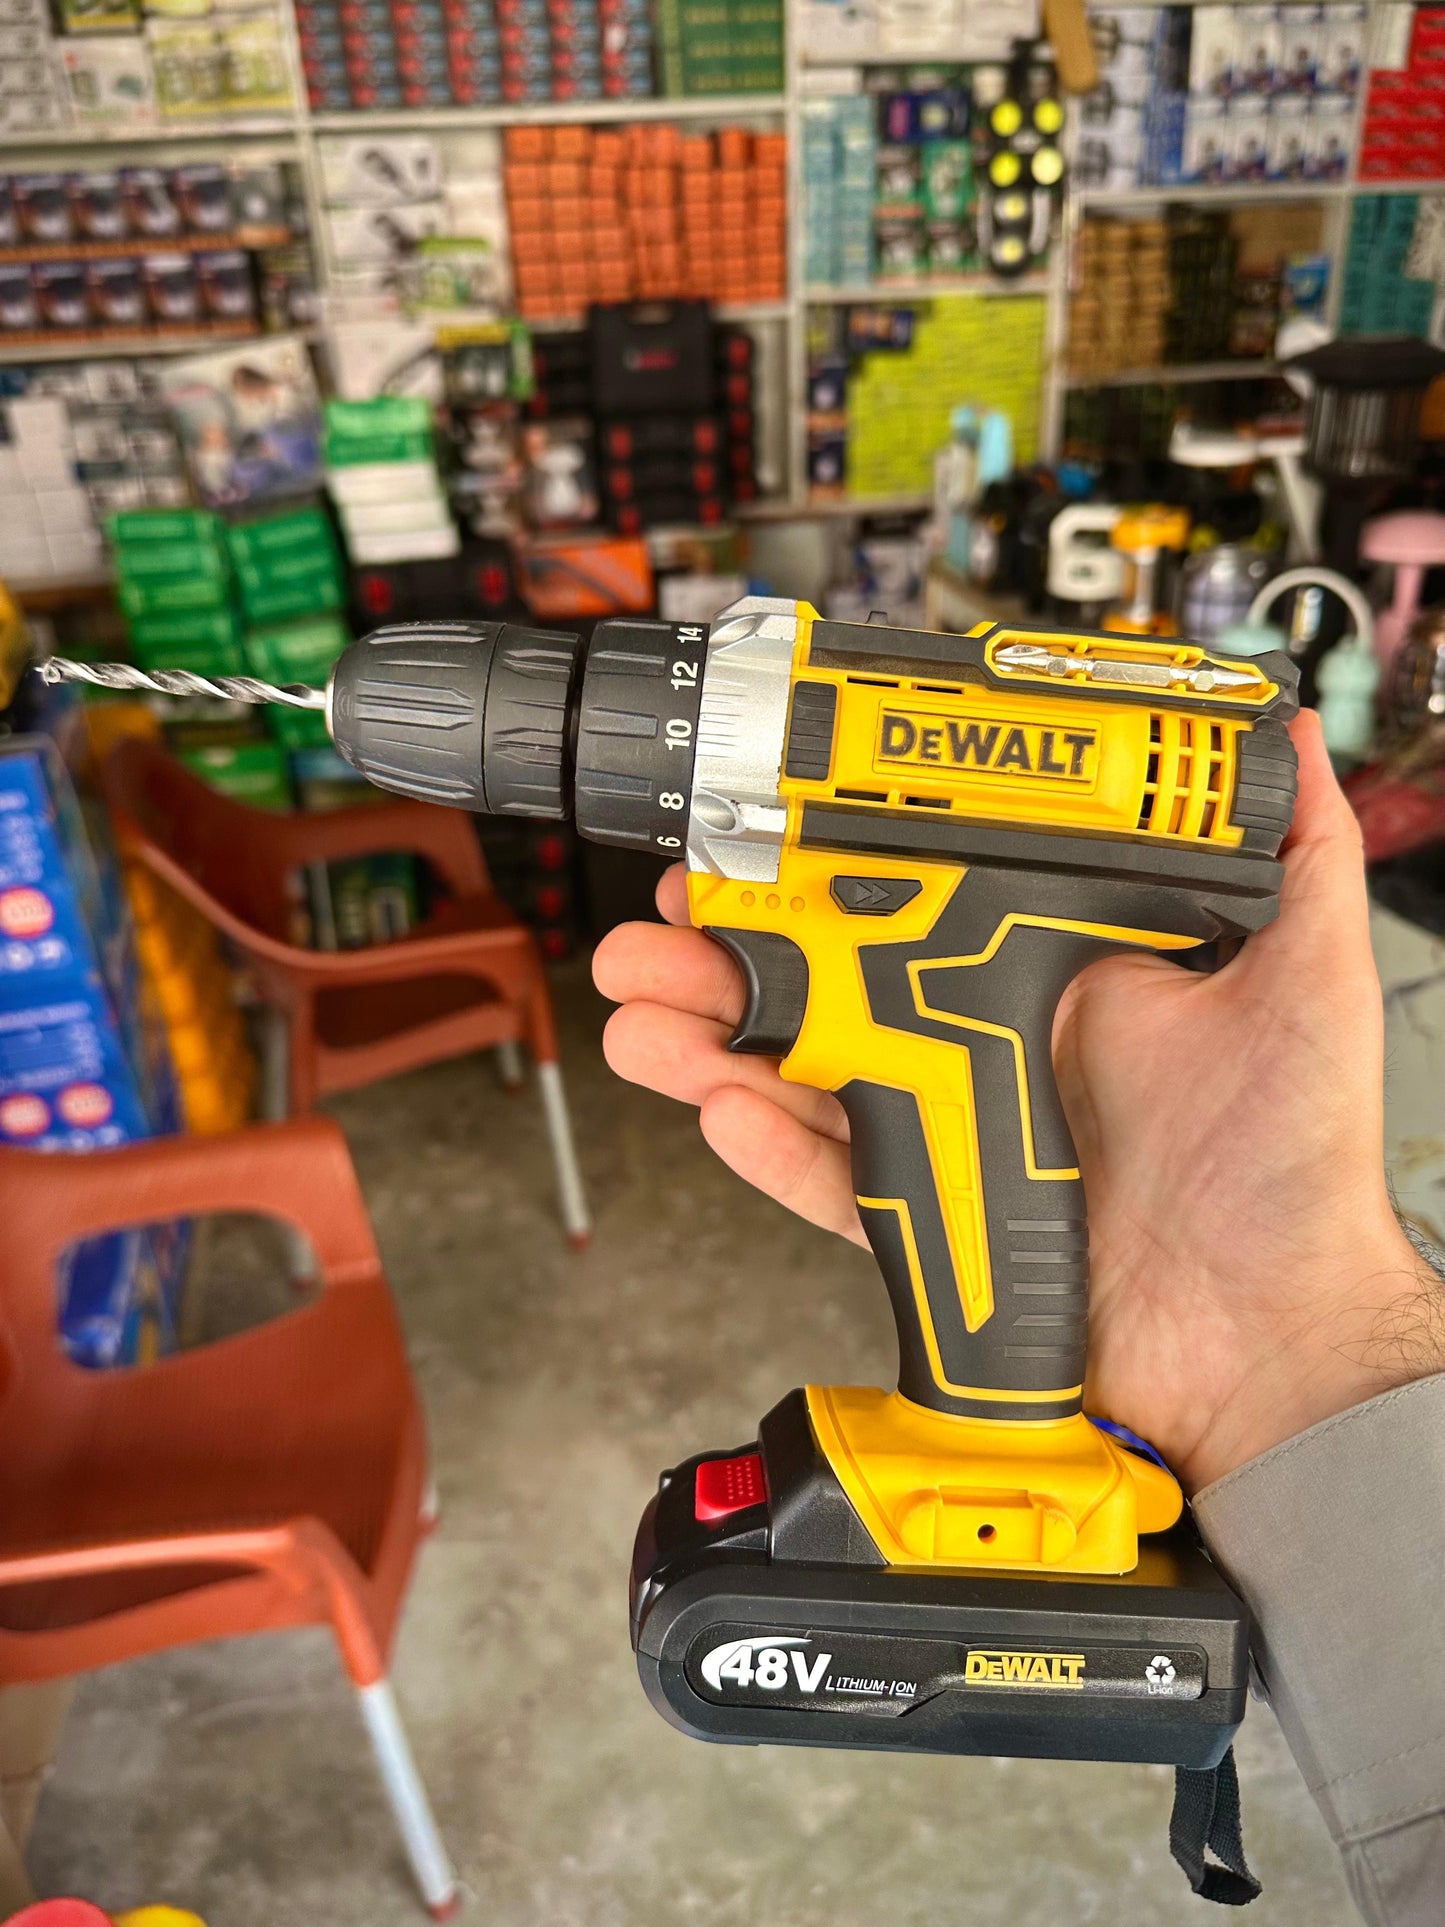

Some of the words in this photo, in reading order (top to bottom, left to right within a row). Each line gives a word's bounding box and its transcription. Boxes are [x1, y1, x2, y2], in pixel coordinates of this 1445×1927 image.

[677, 627, 703, 643] 14
[671, 660, 699, 691] 12
[665, 718, 692, 751] 10
[659, 791, 685, 811] 8
[656, 836, 682, 848] 6
[719, 1645, 822, 1692] 48V
[825, 1675, 917, 1697] LITHIUM-ION
